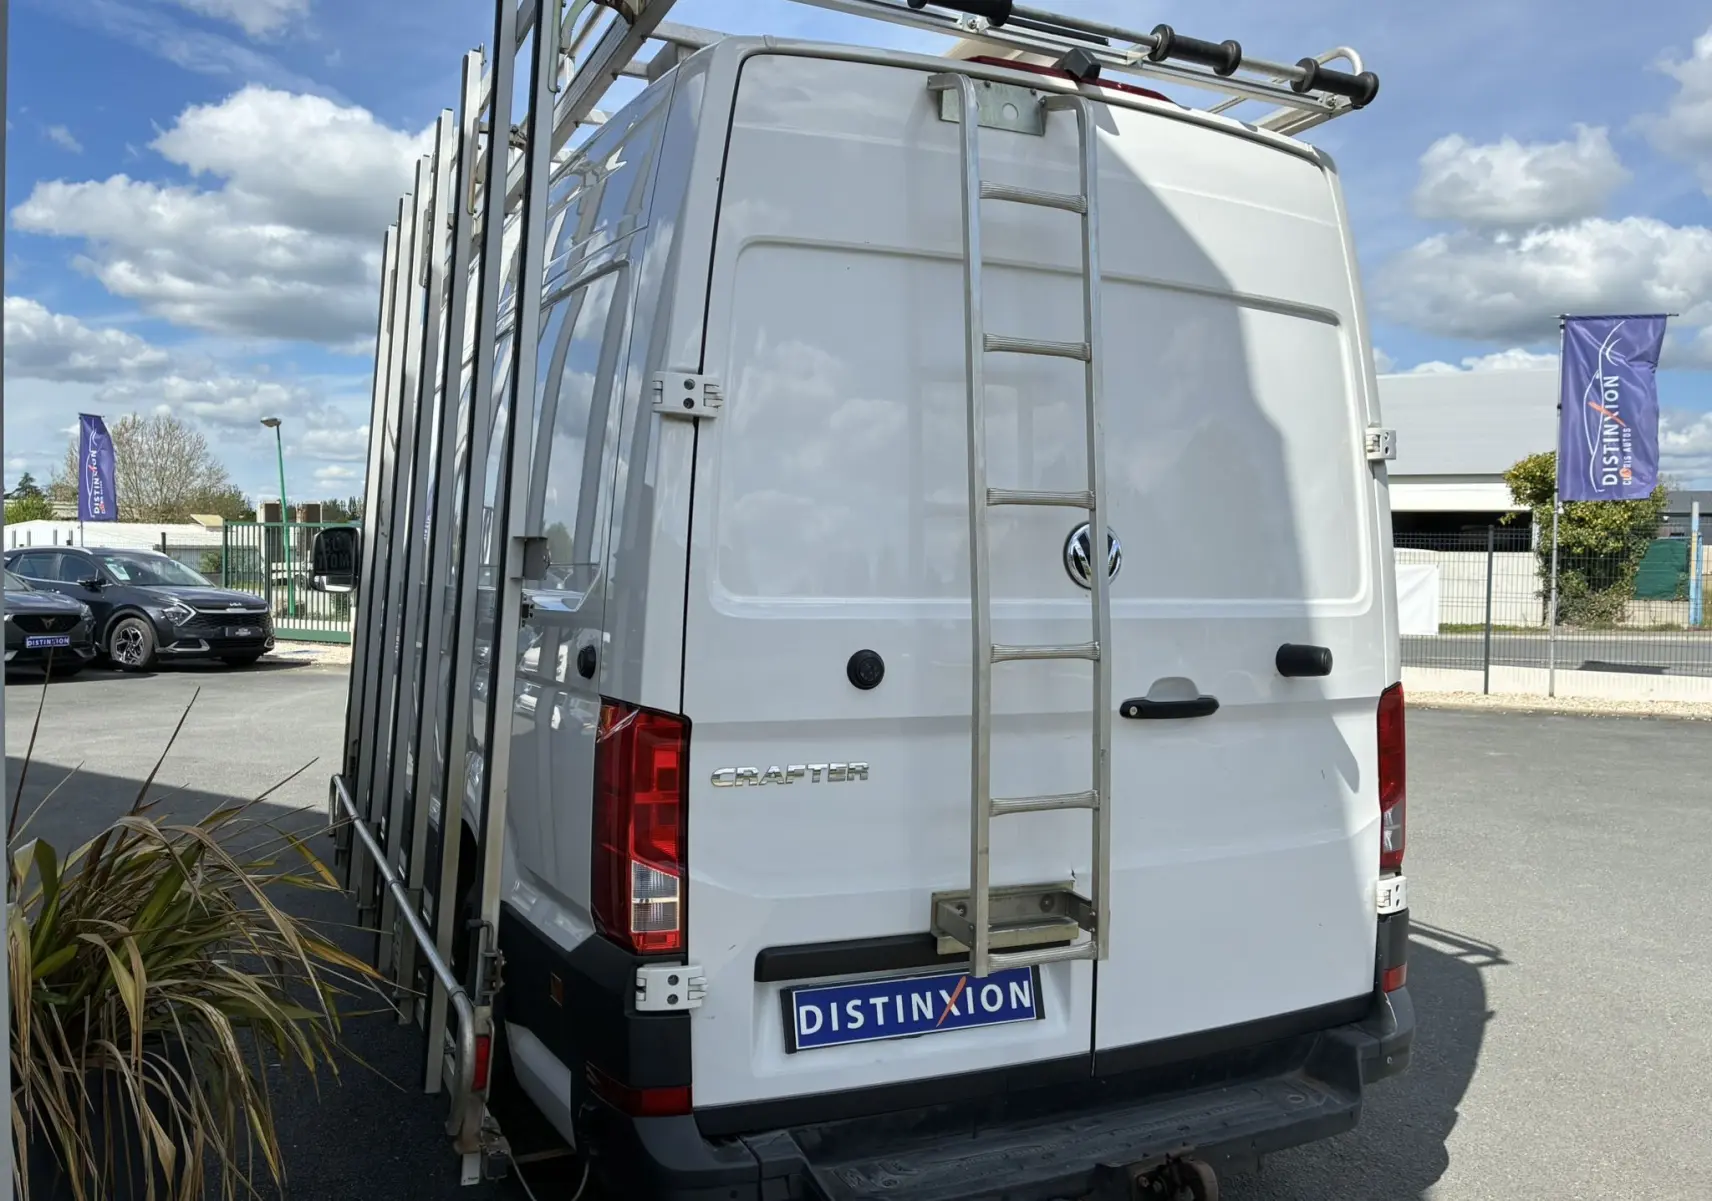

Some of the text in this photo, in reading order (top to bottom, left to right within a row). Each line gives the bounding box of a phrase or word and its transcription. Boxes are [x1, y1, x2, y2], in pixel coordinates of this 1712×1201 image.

[1600, 375, 1621, 486] DISTINXION
[1622, 428, 1631, 452] AUTOS
[710, 761, 869, 787] CRAFTER
[799, 977, 1032, 1036] DISTINXION
